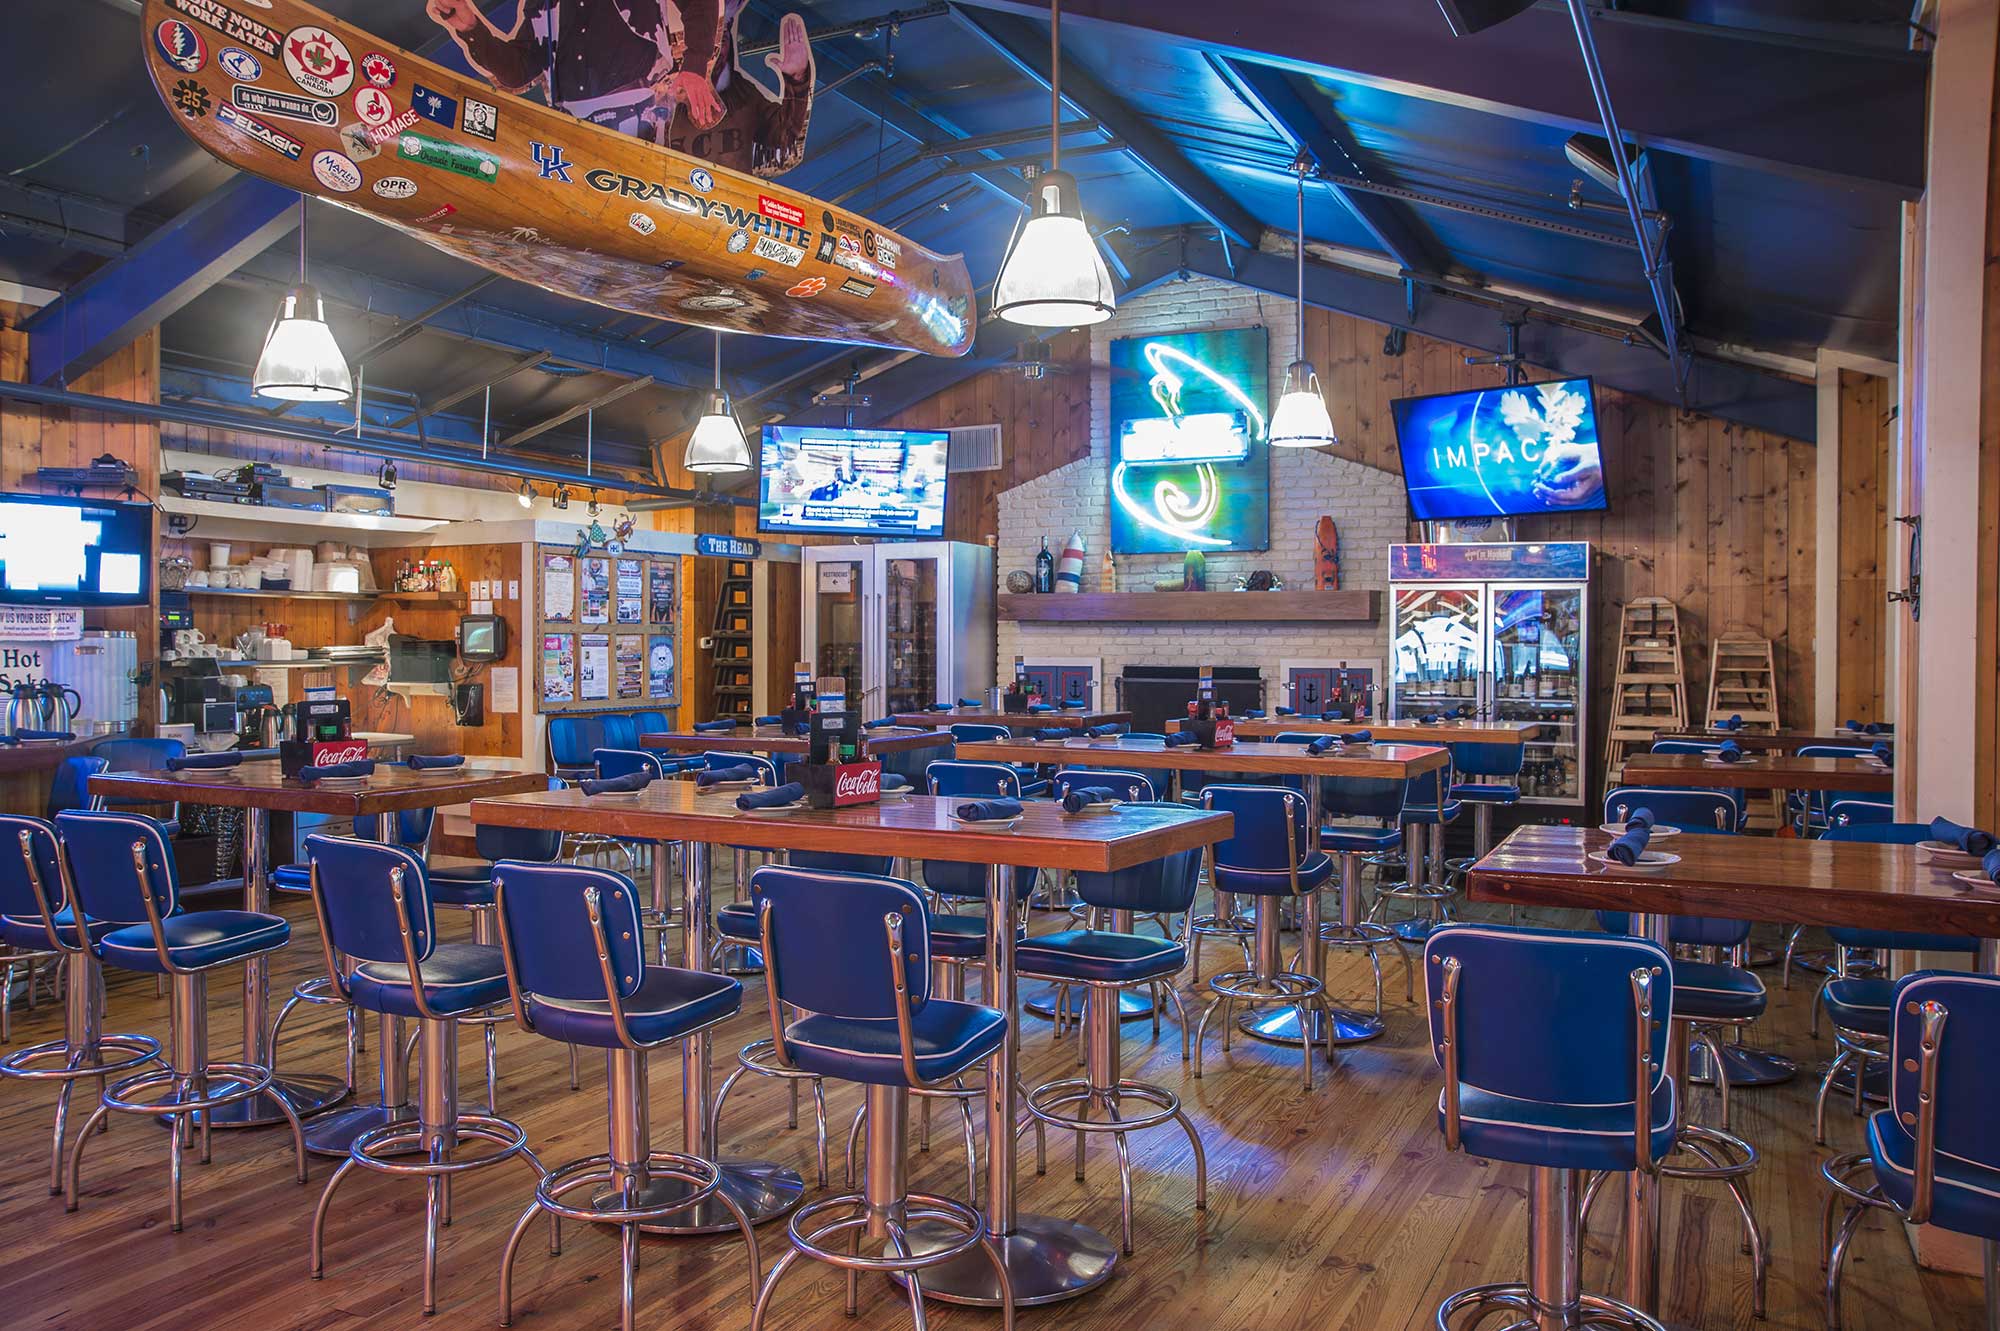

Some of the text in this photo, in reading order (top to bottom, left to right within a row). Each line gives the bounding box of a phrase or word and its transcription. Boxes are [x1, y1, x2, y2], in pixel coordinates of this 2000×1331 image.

[176, 0, 275, 56] WORK LATER
[229, 9, 267, 37] NOW
[295, 76, 335, 95] CANADIAN
[304, 74, 329, 87] GREAT
[182, 88, 201, 108] 25
[220, 106, 302, 156] PELAGIC
[371, 109, 420, 146] HOMAGE
[529, 141, 573, 184] UK
[380, 179, 407, 190] OPR
[584, 168, 813, 249] GRADY-WHITE
[708, 538, 754, 555] THE HEAD
[5, 612, 15, 624] US
[16, 612, 34, 624] YOUR
[35, 613, 51, 624] BEST
[3, 649, 41, 668] Hot
[315, 746, 366, 768] Coca-Cola
[836, 769, 881, 798] Coca-Cola
